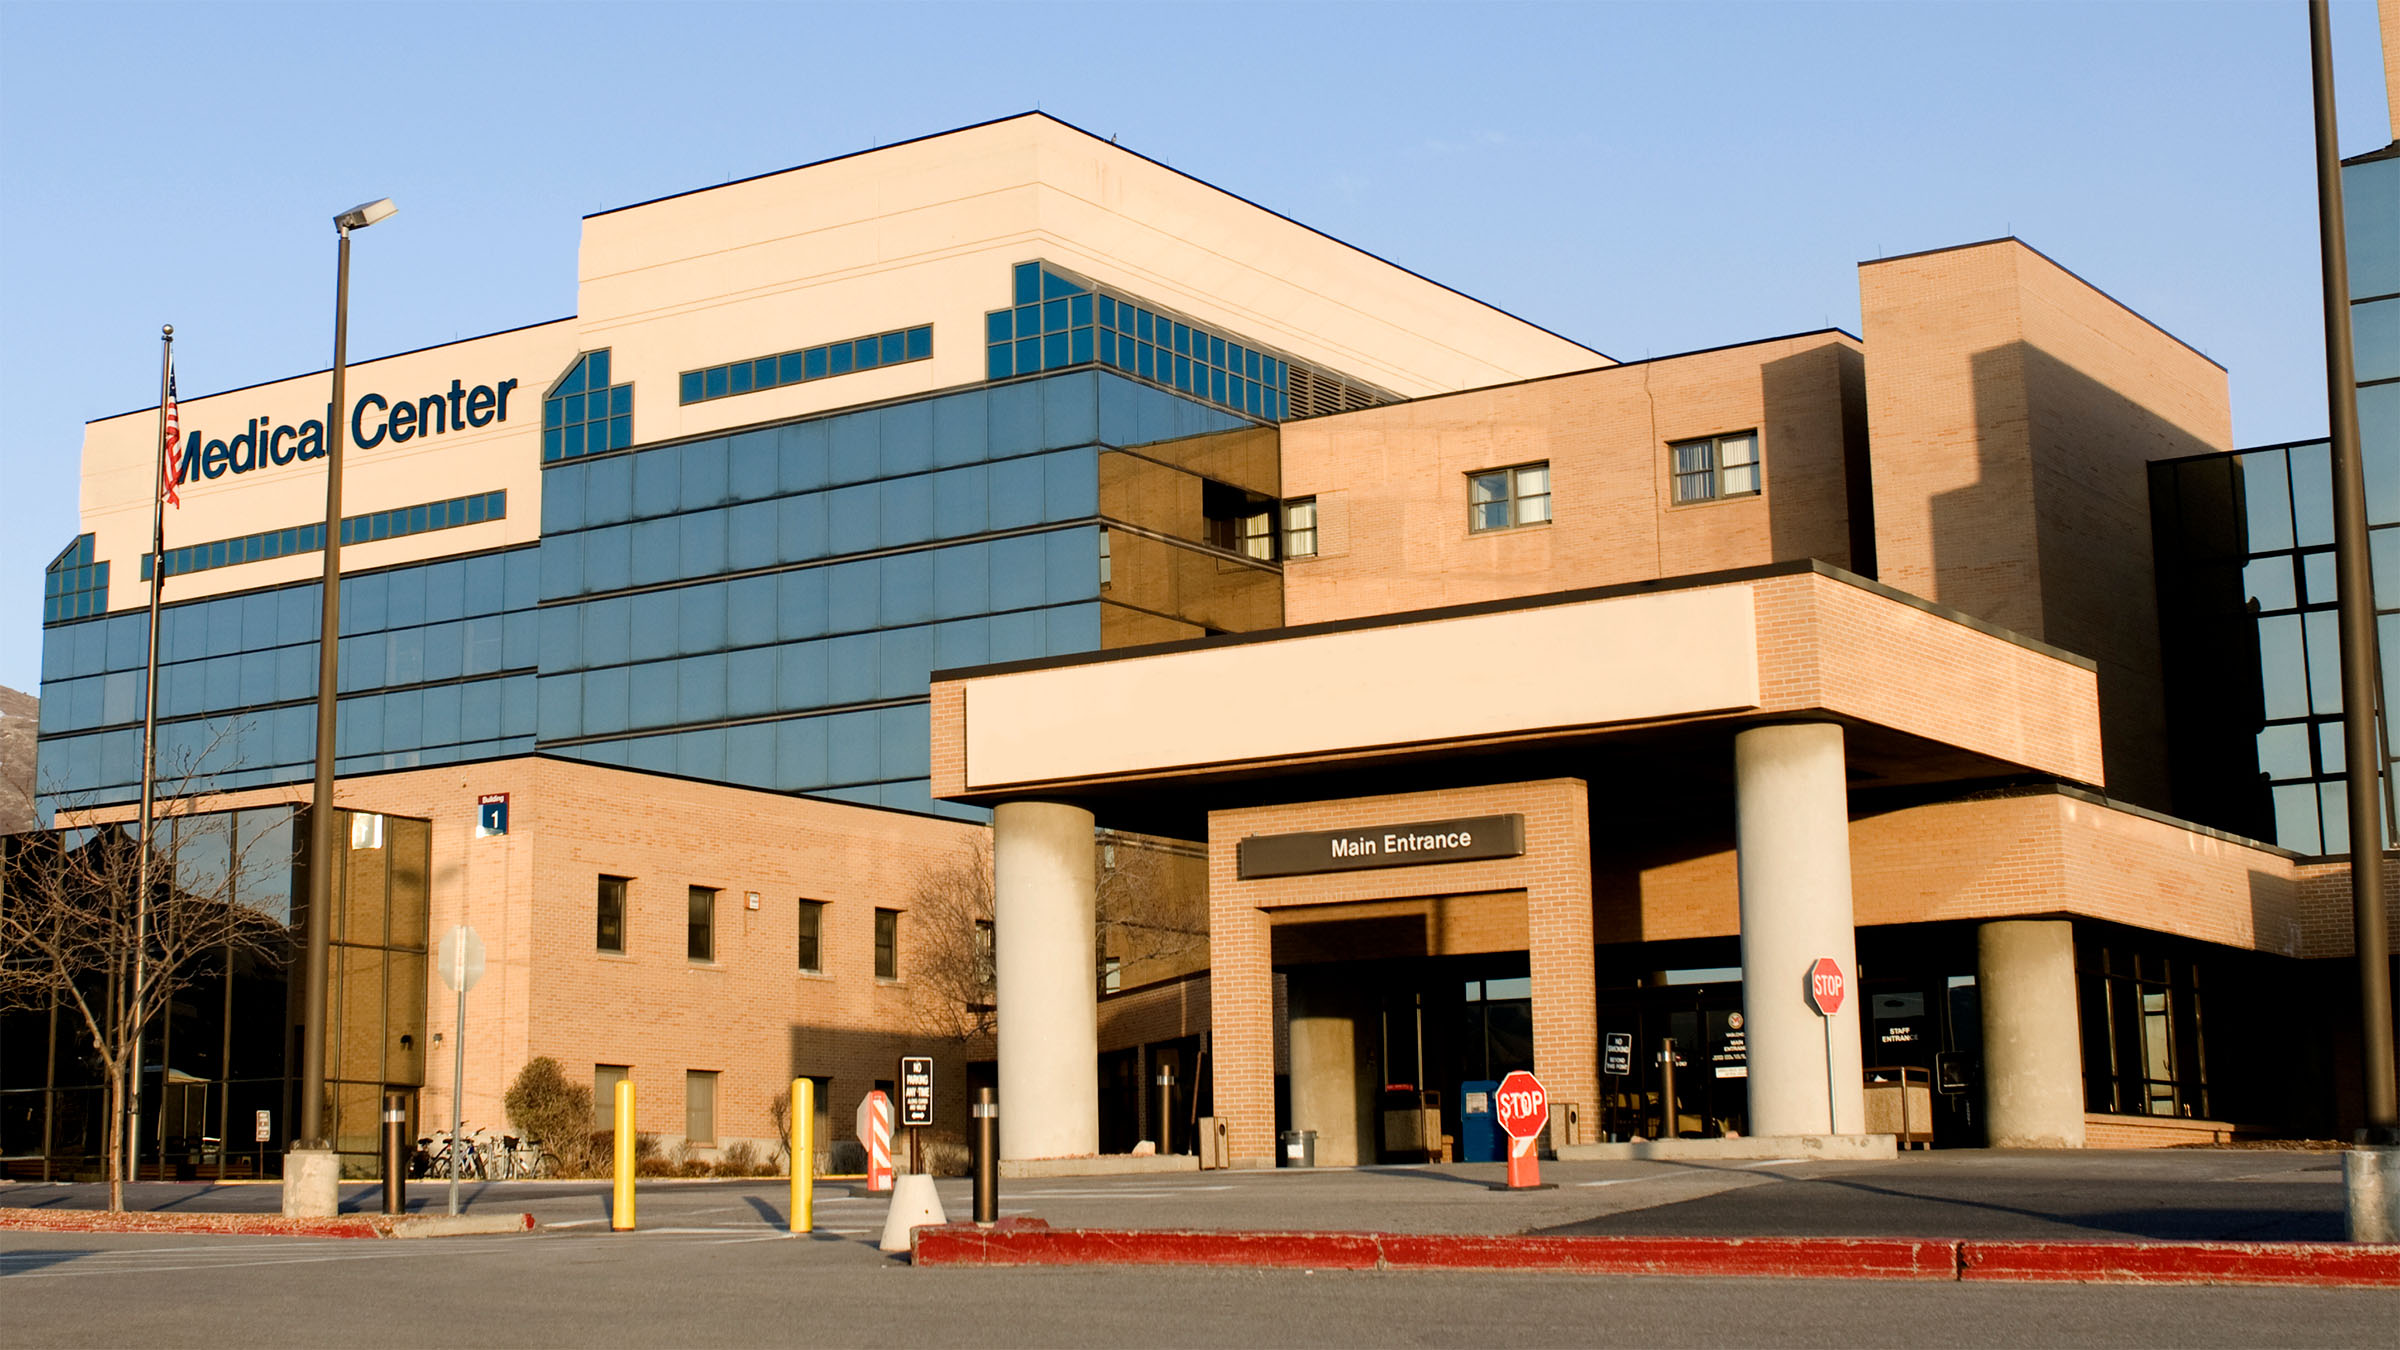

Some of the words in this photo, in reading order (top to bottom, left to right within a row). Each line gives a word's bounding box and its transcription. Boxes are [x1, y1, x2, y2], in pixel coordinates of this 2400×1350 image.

[351, 378, 518, 450] Center
[482, 795, 505, 804] Building
[491, 810, 499, 829] 1
[1331, 836, 1377, 858] Main
[1384, 831, 1472, 853] Entrance
[1814, 974, 1843, 997] STOP
[1889, 1027, 1911, 1035] STAFF
[1614, 1037, 1623, 1046] NO
[1881, 1033, 1919, 1043] ENTRANCE
[913, 1062, 922, 1073] NO
[906, 1074, 929, 1086] PARKING
[1500, 1090, 1543, 1120] STOP
